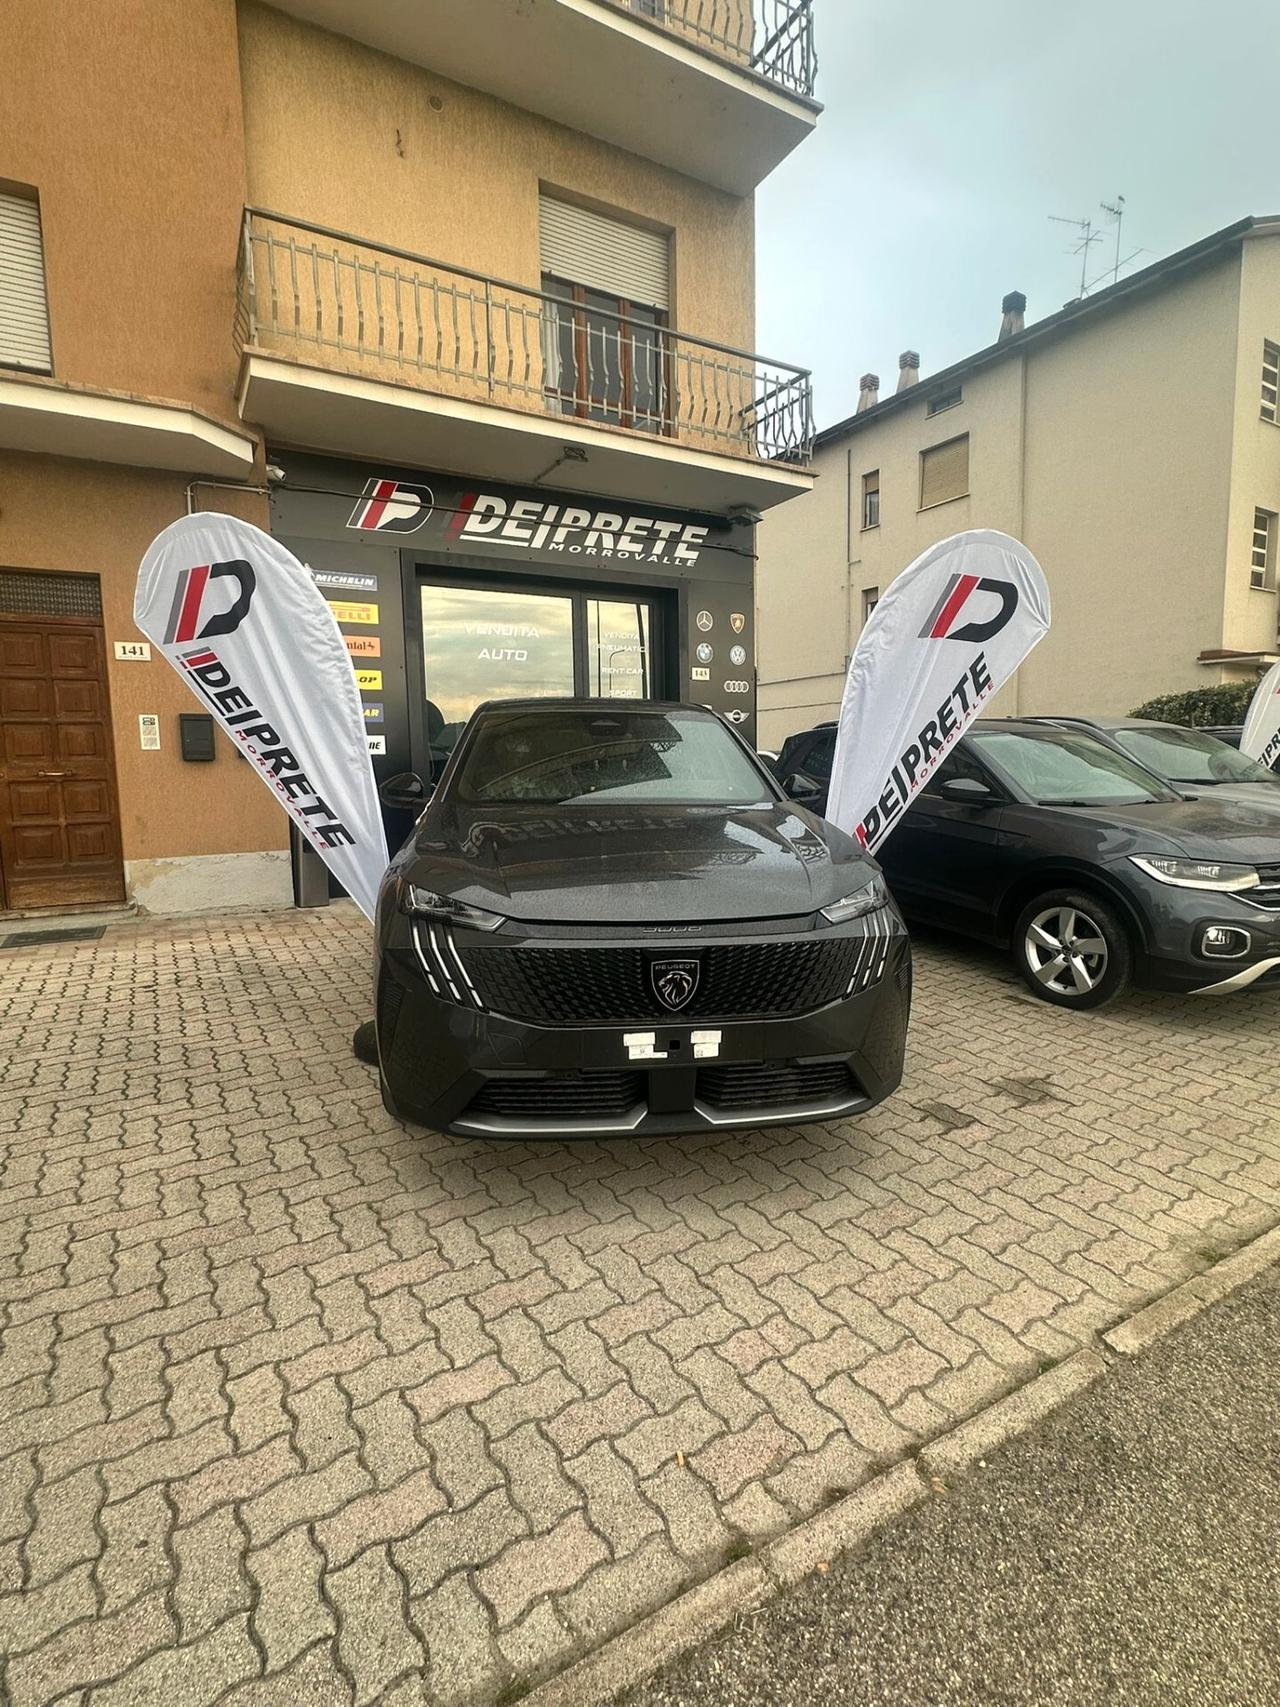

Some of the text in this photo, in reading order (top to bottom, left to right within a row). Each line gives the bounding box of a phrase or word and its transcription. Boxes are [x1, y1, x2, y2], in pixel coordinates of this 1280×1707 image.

[549, 542, 697, 567] MORROVALLE
[315, 574, 374, 586] MICHELIN
[463, 622, 540, 638] VENDITA
[121, 646, 144, 656] 141
[478, 648, 528, 661] AUTO
[911, 680, 994, 793] MORROVALLE
[235, 730, 330, 849] MORROVALLE
